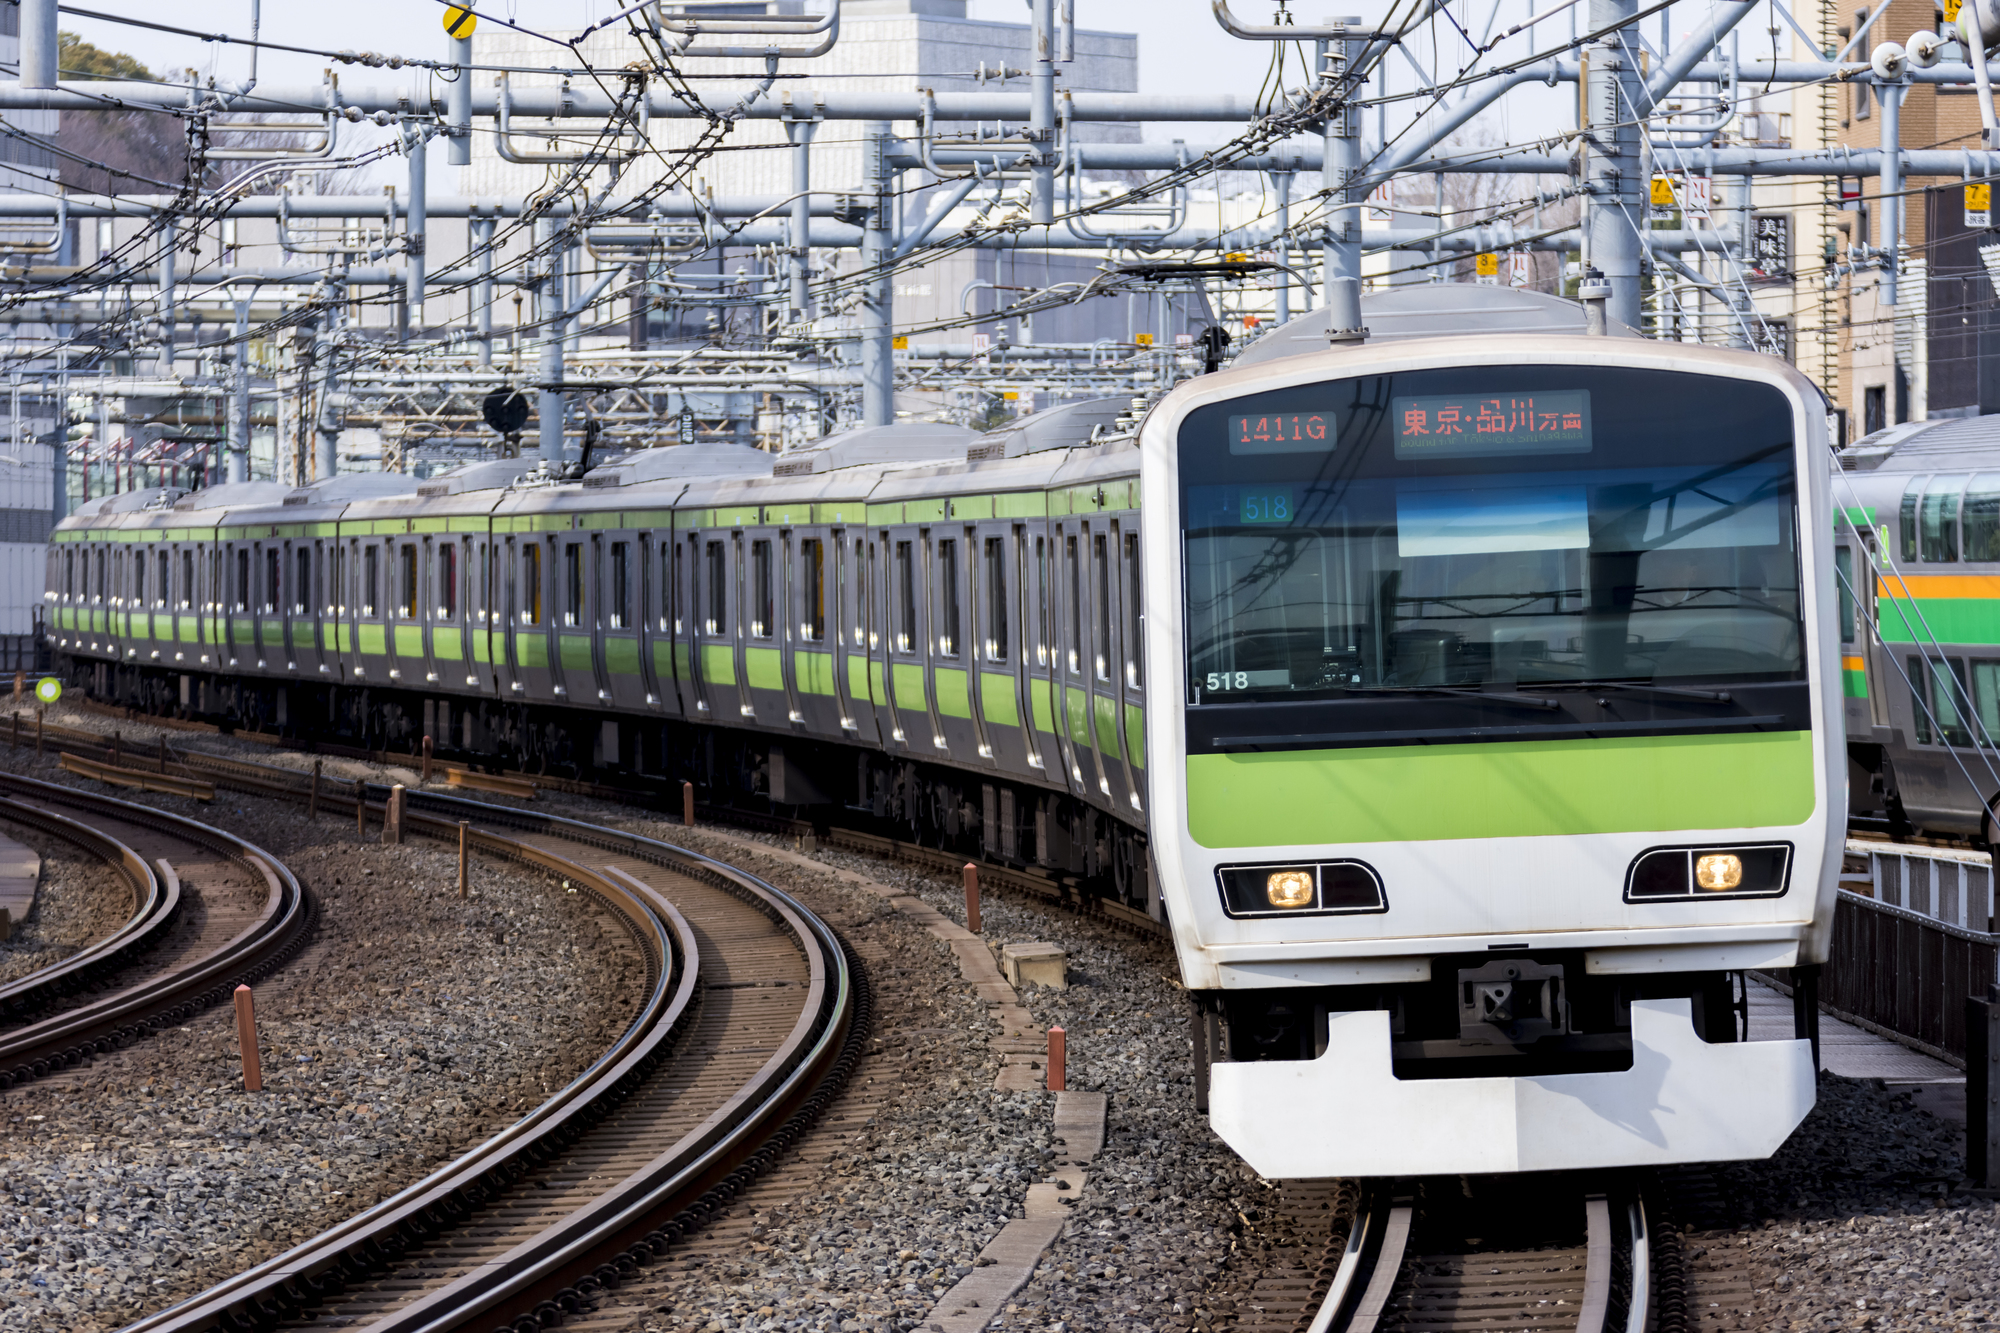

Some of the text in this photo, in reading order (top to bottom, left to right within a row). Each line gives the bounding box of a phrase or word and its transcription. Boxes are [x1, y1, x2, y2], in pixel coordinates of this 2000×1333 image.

[1970, 185, 1979, 199] 7
[893, 284, 932, 296] 美術館
[1241, 415, 1326, 443] 1411G
[1246, 495, 1288, 520] 518
[1206, 671, 1249, 691] 518
